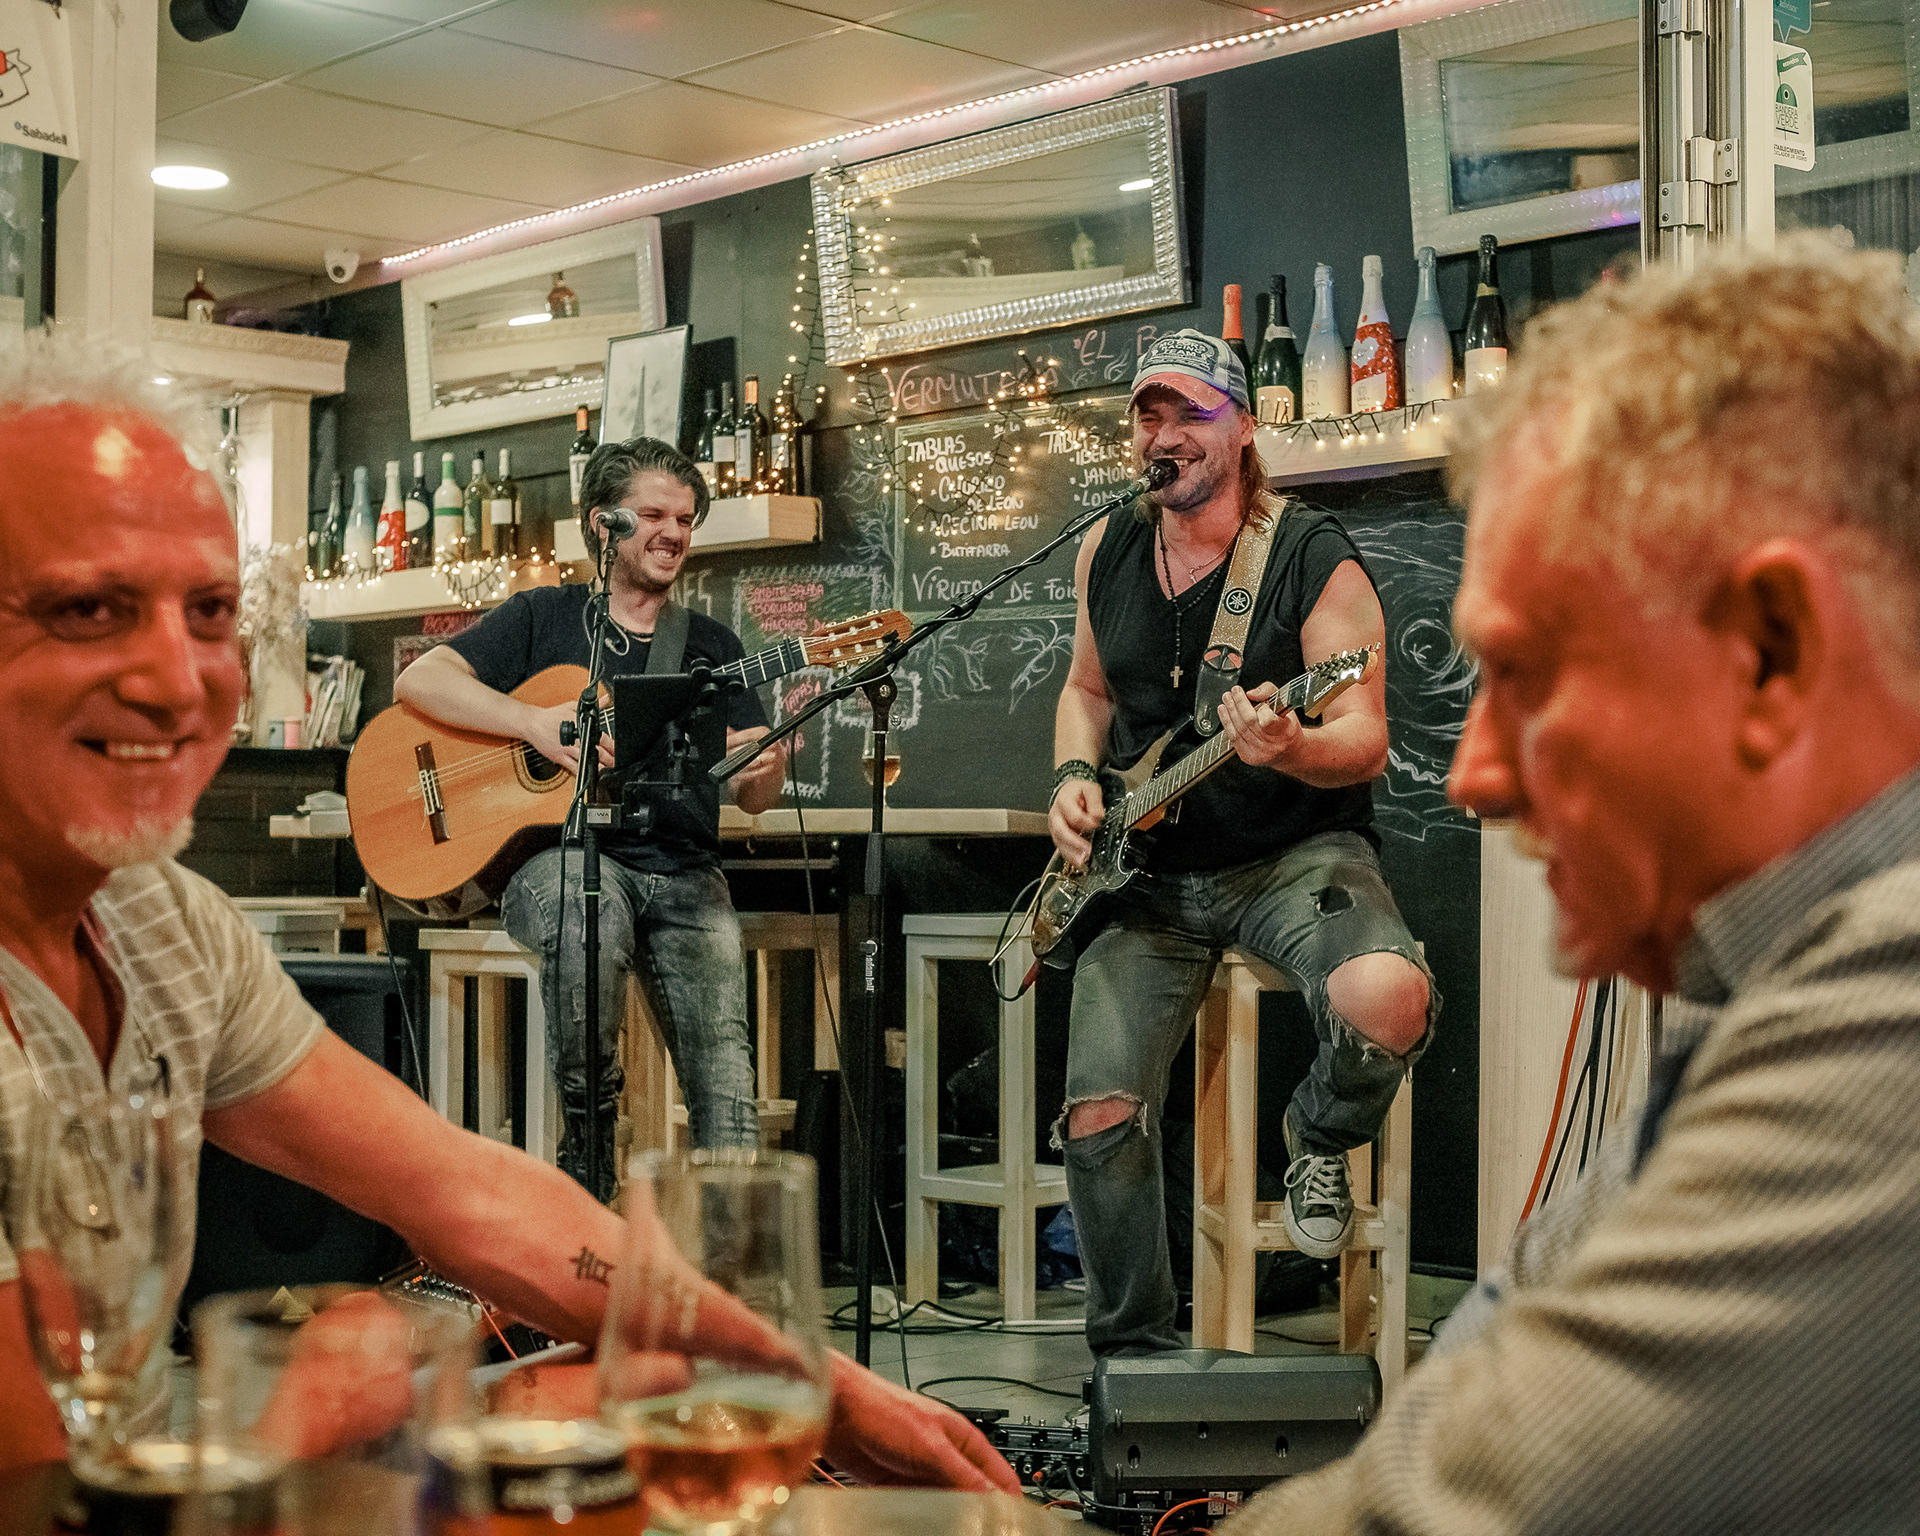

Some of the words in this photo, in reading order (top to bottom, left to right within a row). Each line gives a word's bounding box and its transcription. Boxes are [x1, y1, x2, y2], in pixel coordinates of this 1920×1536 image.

[1775, 103, 1798, 118] BANDERA
[1775, 112, 1799, 130] VERDE
[22, 124, 68, 147] Sabadell
[1163, 349, 1197, 357] TEAM
[907, 434, 967, 463] TABLAS
[935, 451, 994, 474] QUESOS
[987, 494, 1024, 512] LEON
[940, 513, 998, 538] CECINA
[1004, 514, 1040, 532] LEON
[1004, 580, 1034, 604] DE
[782, 681, 814, 713] TAPAS
